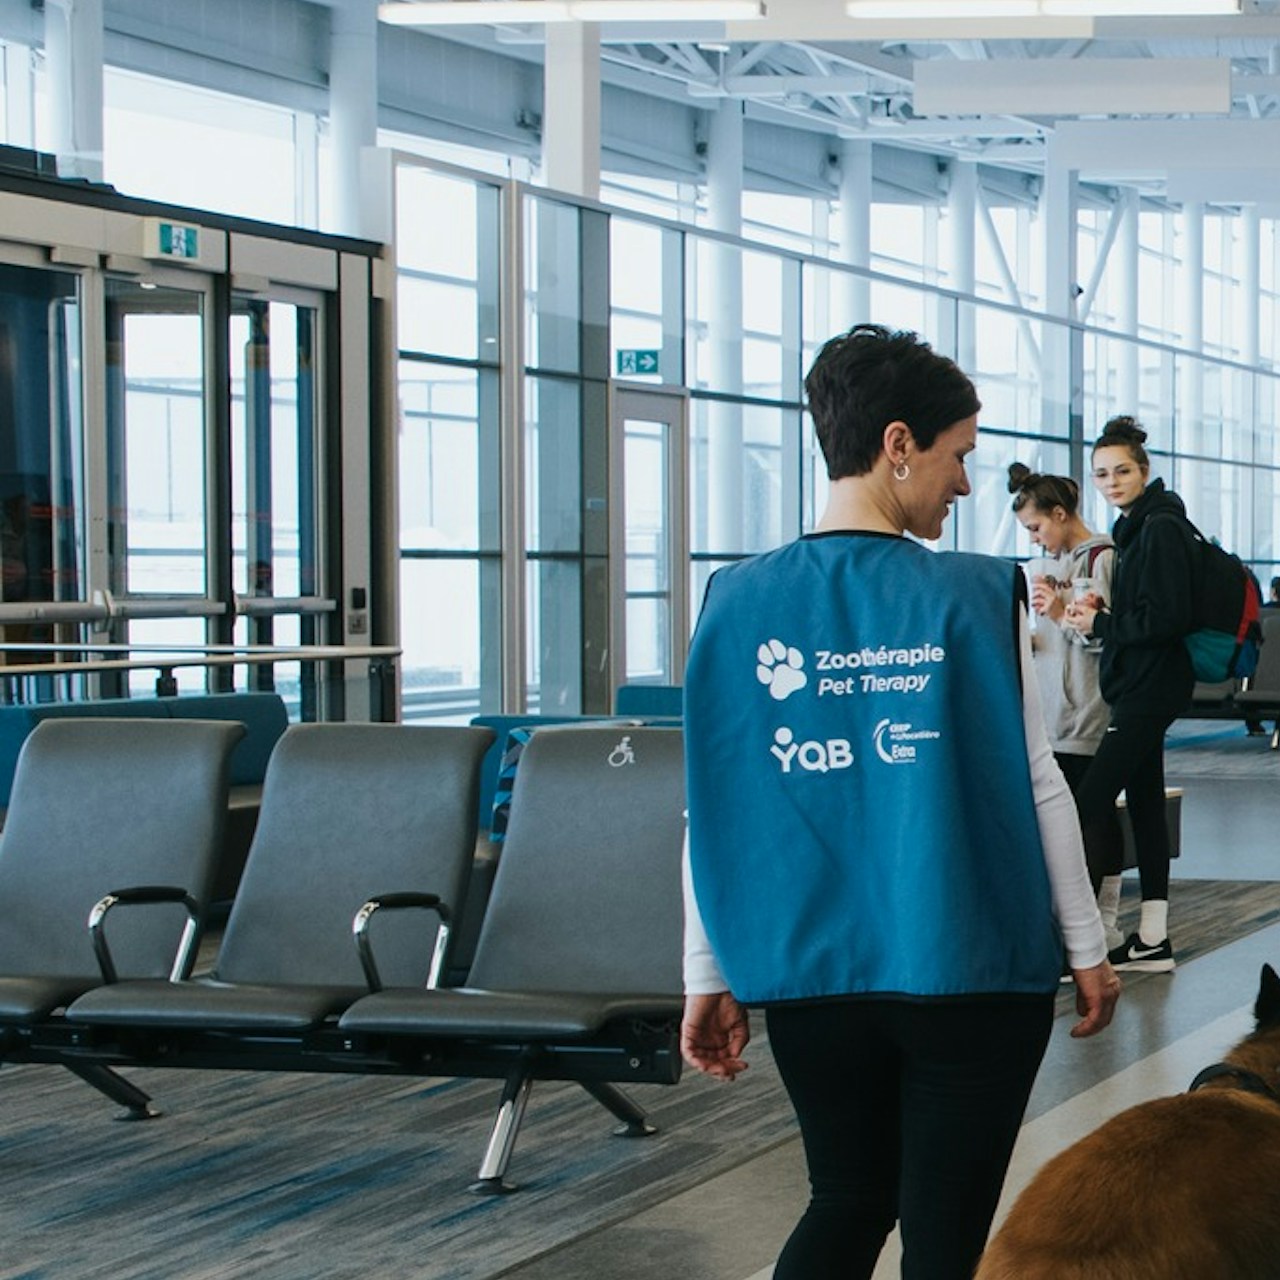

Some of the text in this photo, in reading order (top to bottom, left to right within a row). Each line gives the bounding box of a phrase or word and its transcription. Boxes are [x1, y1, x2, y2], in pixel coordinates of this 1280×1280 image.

[815, 644, 945, 670] Zoothérapie
[818, 677, 854, 696] Pet
[770, 727, 854, 773] YQB
